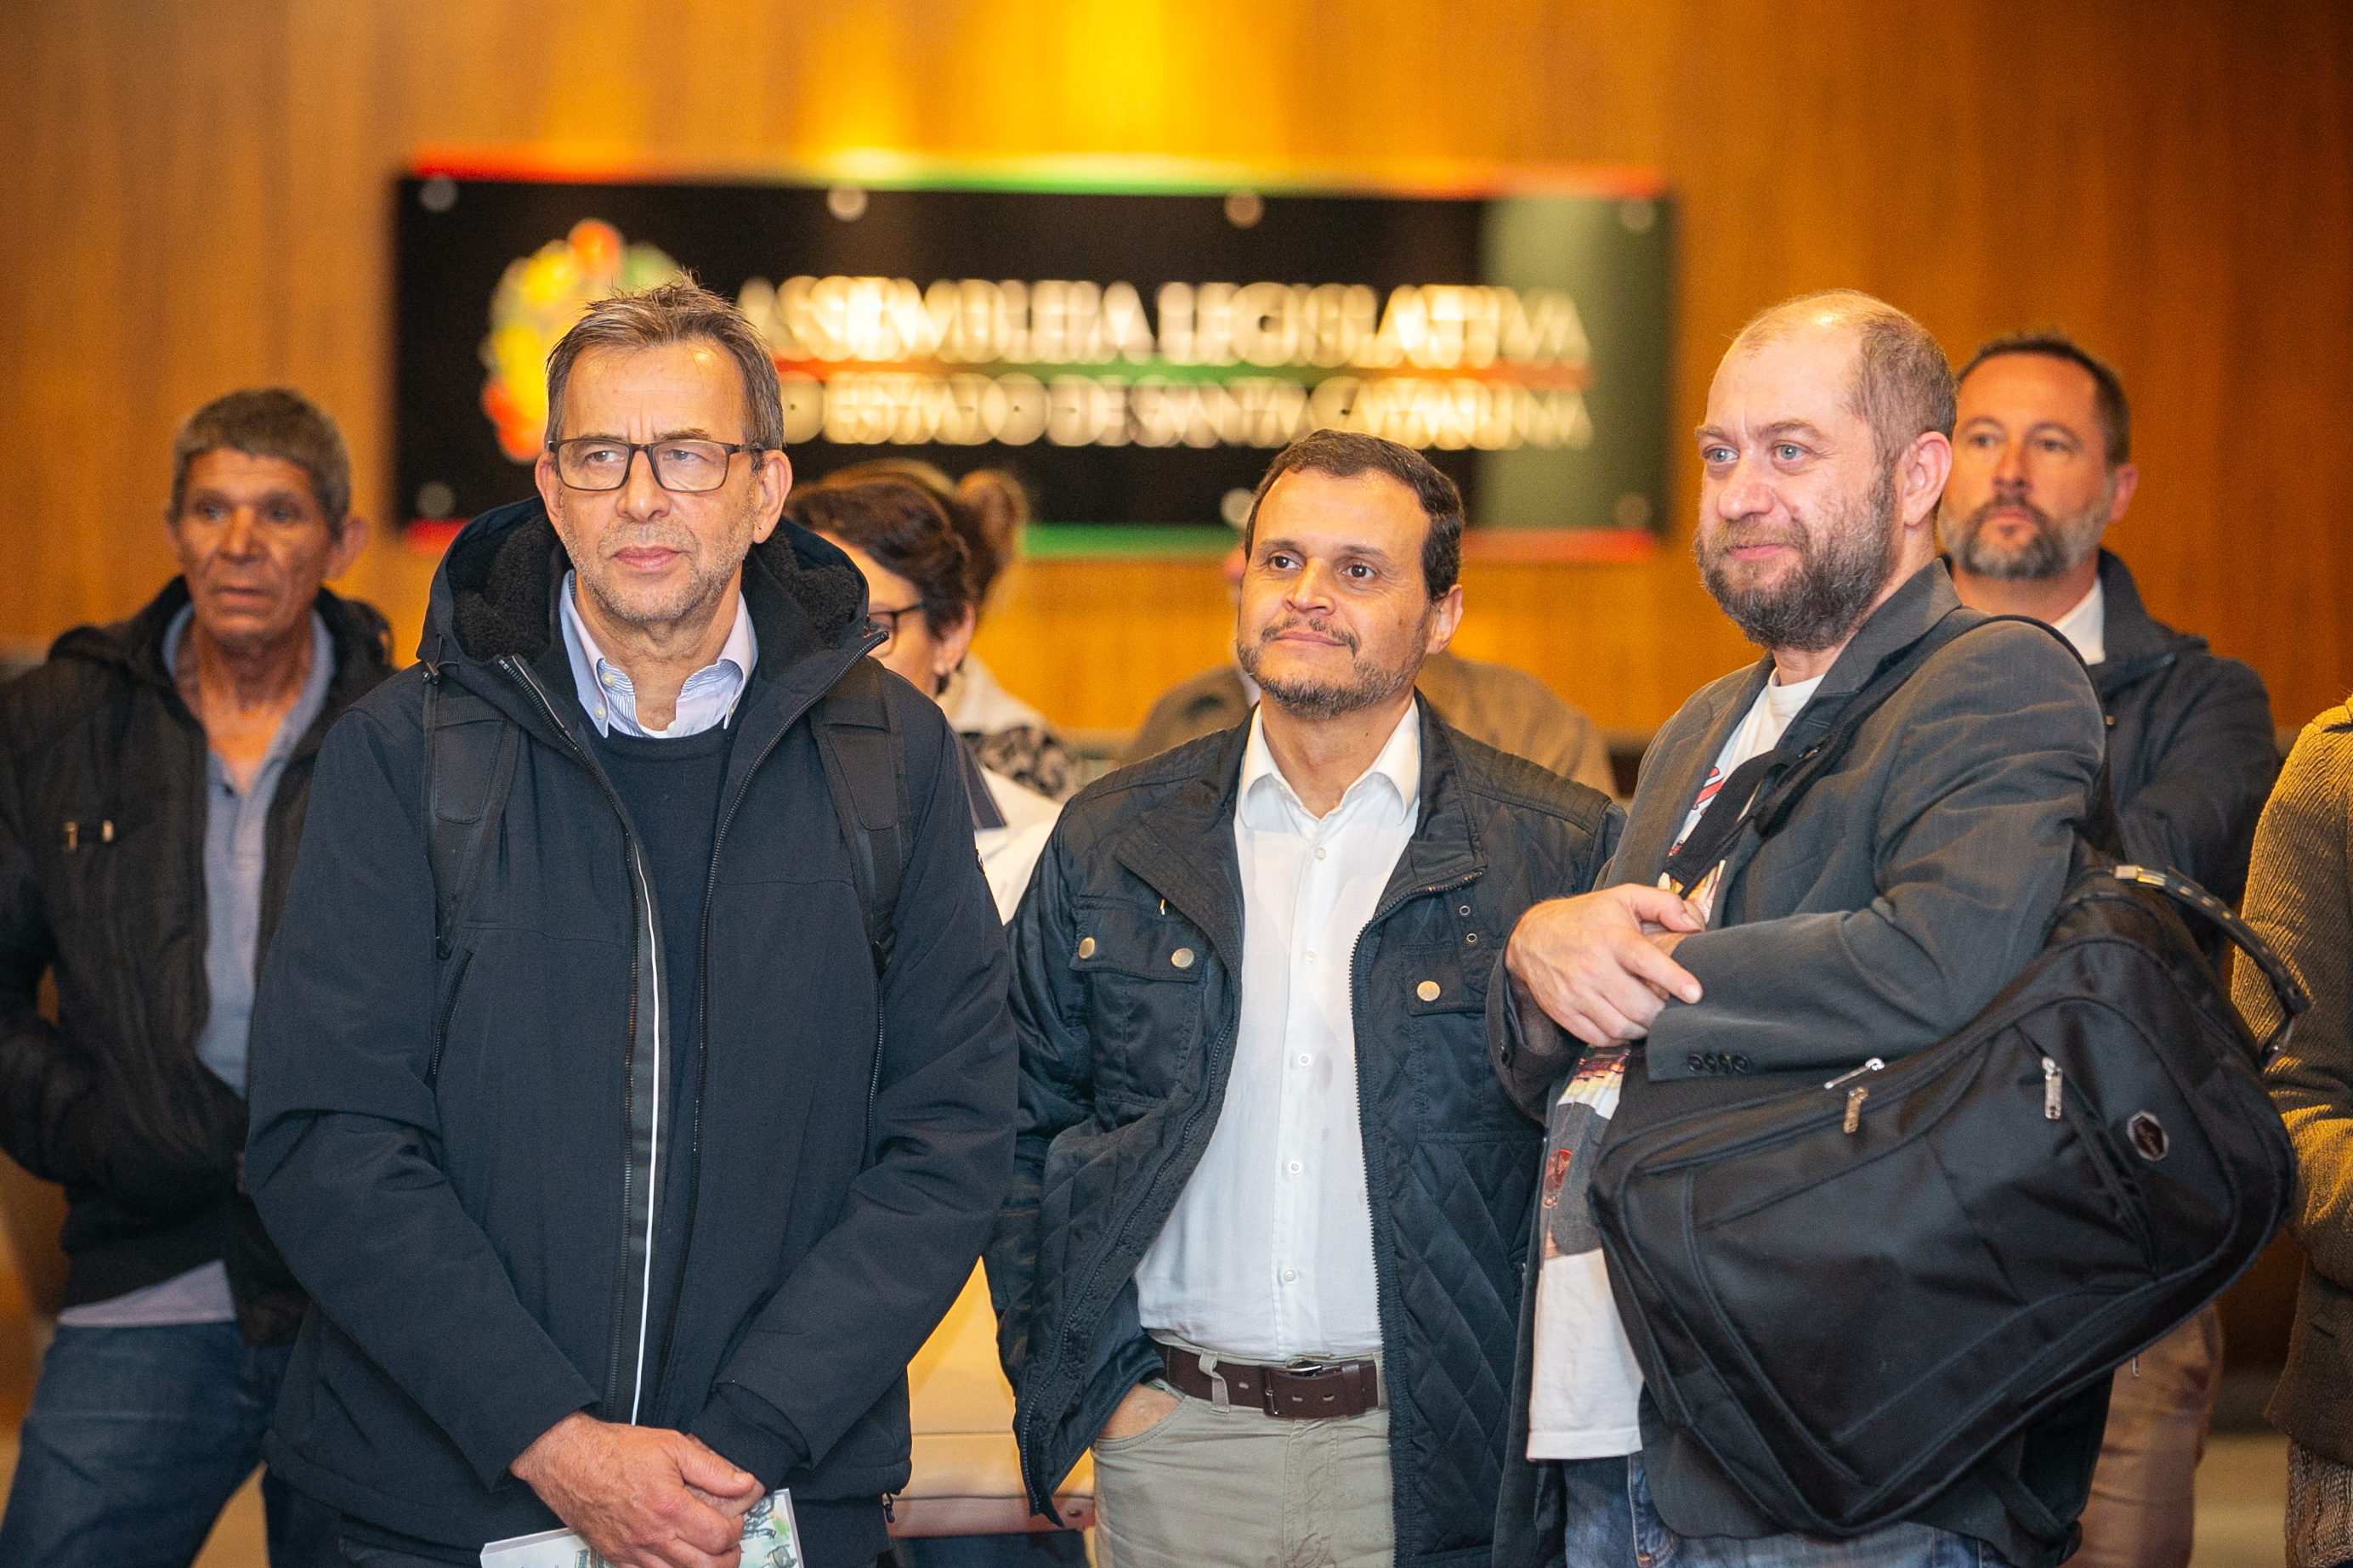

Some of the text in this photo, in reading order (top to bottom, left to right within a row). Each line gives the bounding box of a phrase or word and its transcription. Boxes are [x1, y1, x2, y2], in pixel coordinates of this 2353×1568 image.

[737, 275, 1590, 369] ASSEMBLEIA LEGISLATIVA
[776, 371, 1595, 450] O ESTADO DE SANTA CATARINA
